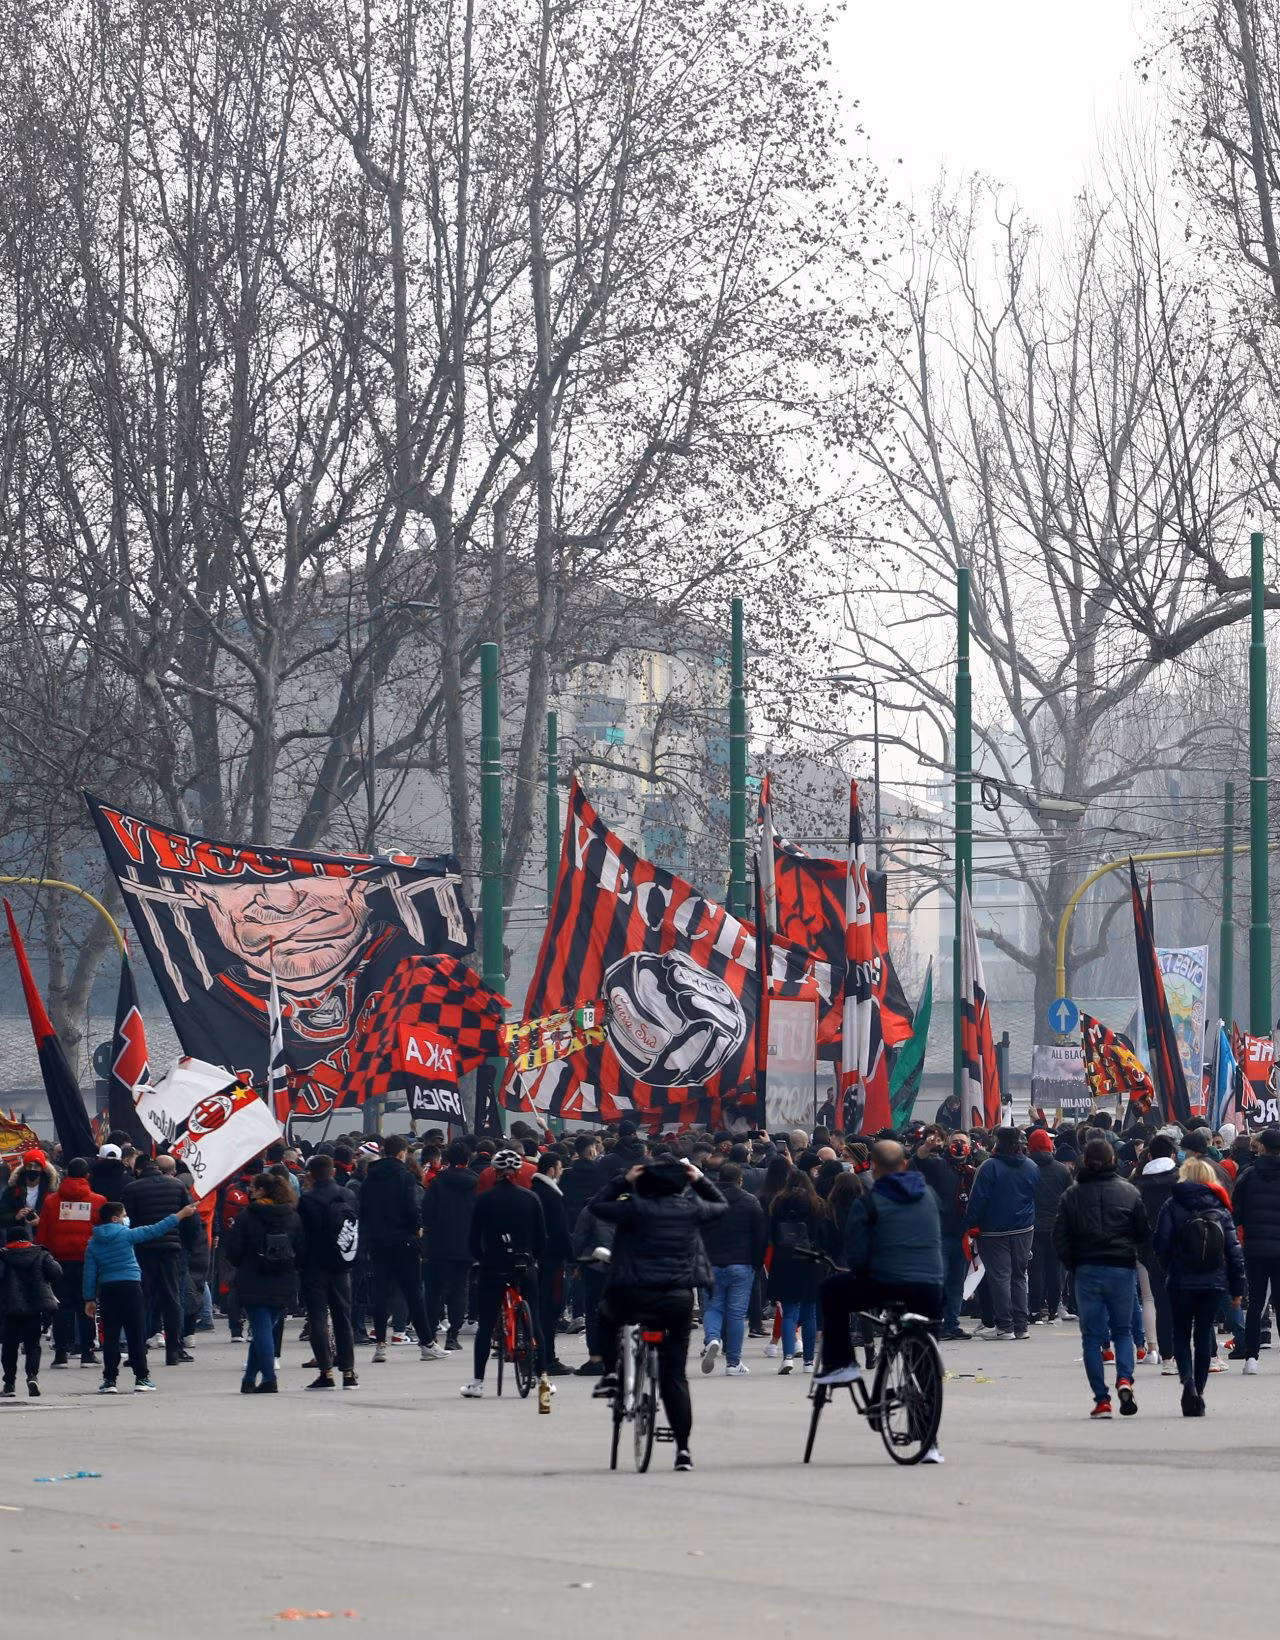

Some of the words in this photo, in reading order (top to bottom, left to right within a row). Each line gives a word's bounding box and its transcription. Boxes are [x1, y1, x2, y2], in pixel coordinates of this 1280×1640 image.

[584, 1011, 594, 1023] 18
[612, 993, 633, 1031] Curva
[635, 1023, 657, 1049] Sud
[1051, 1049, 1063, 1060] ALL
